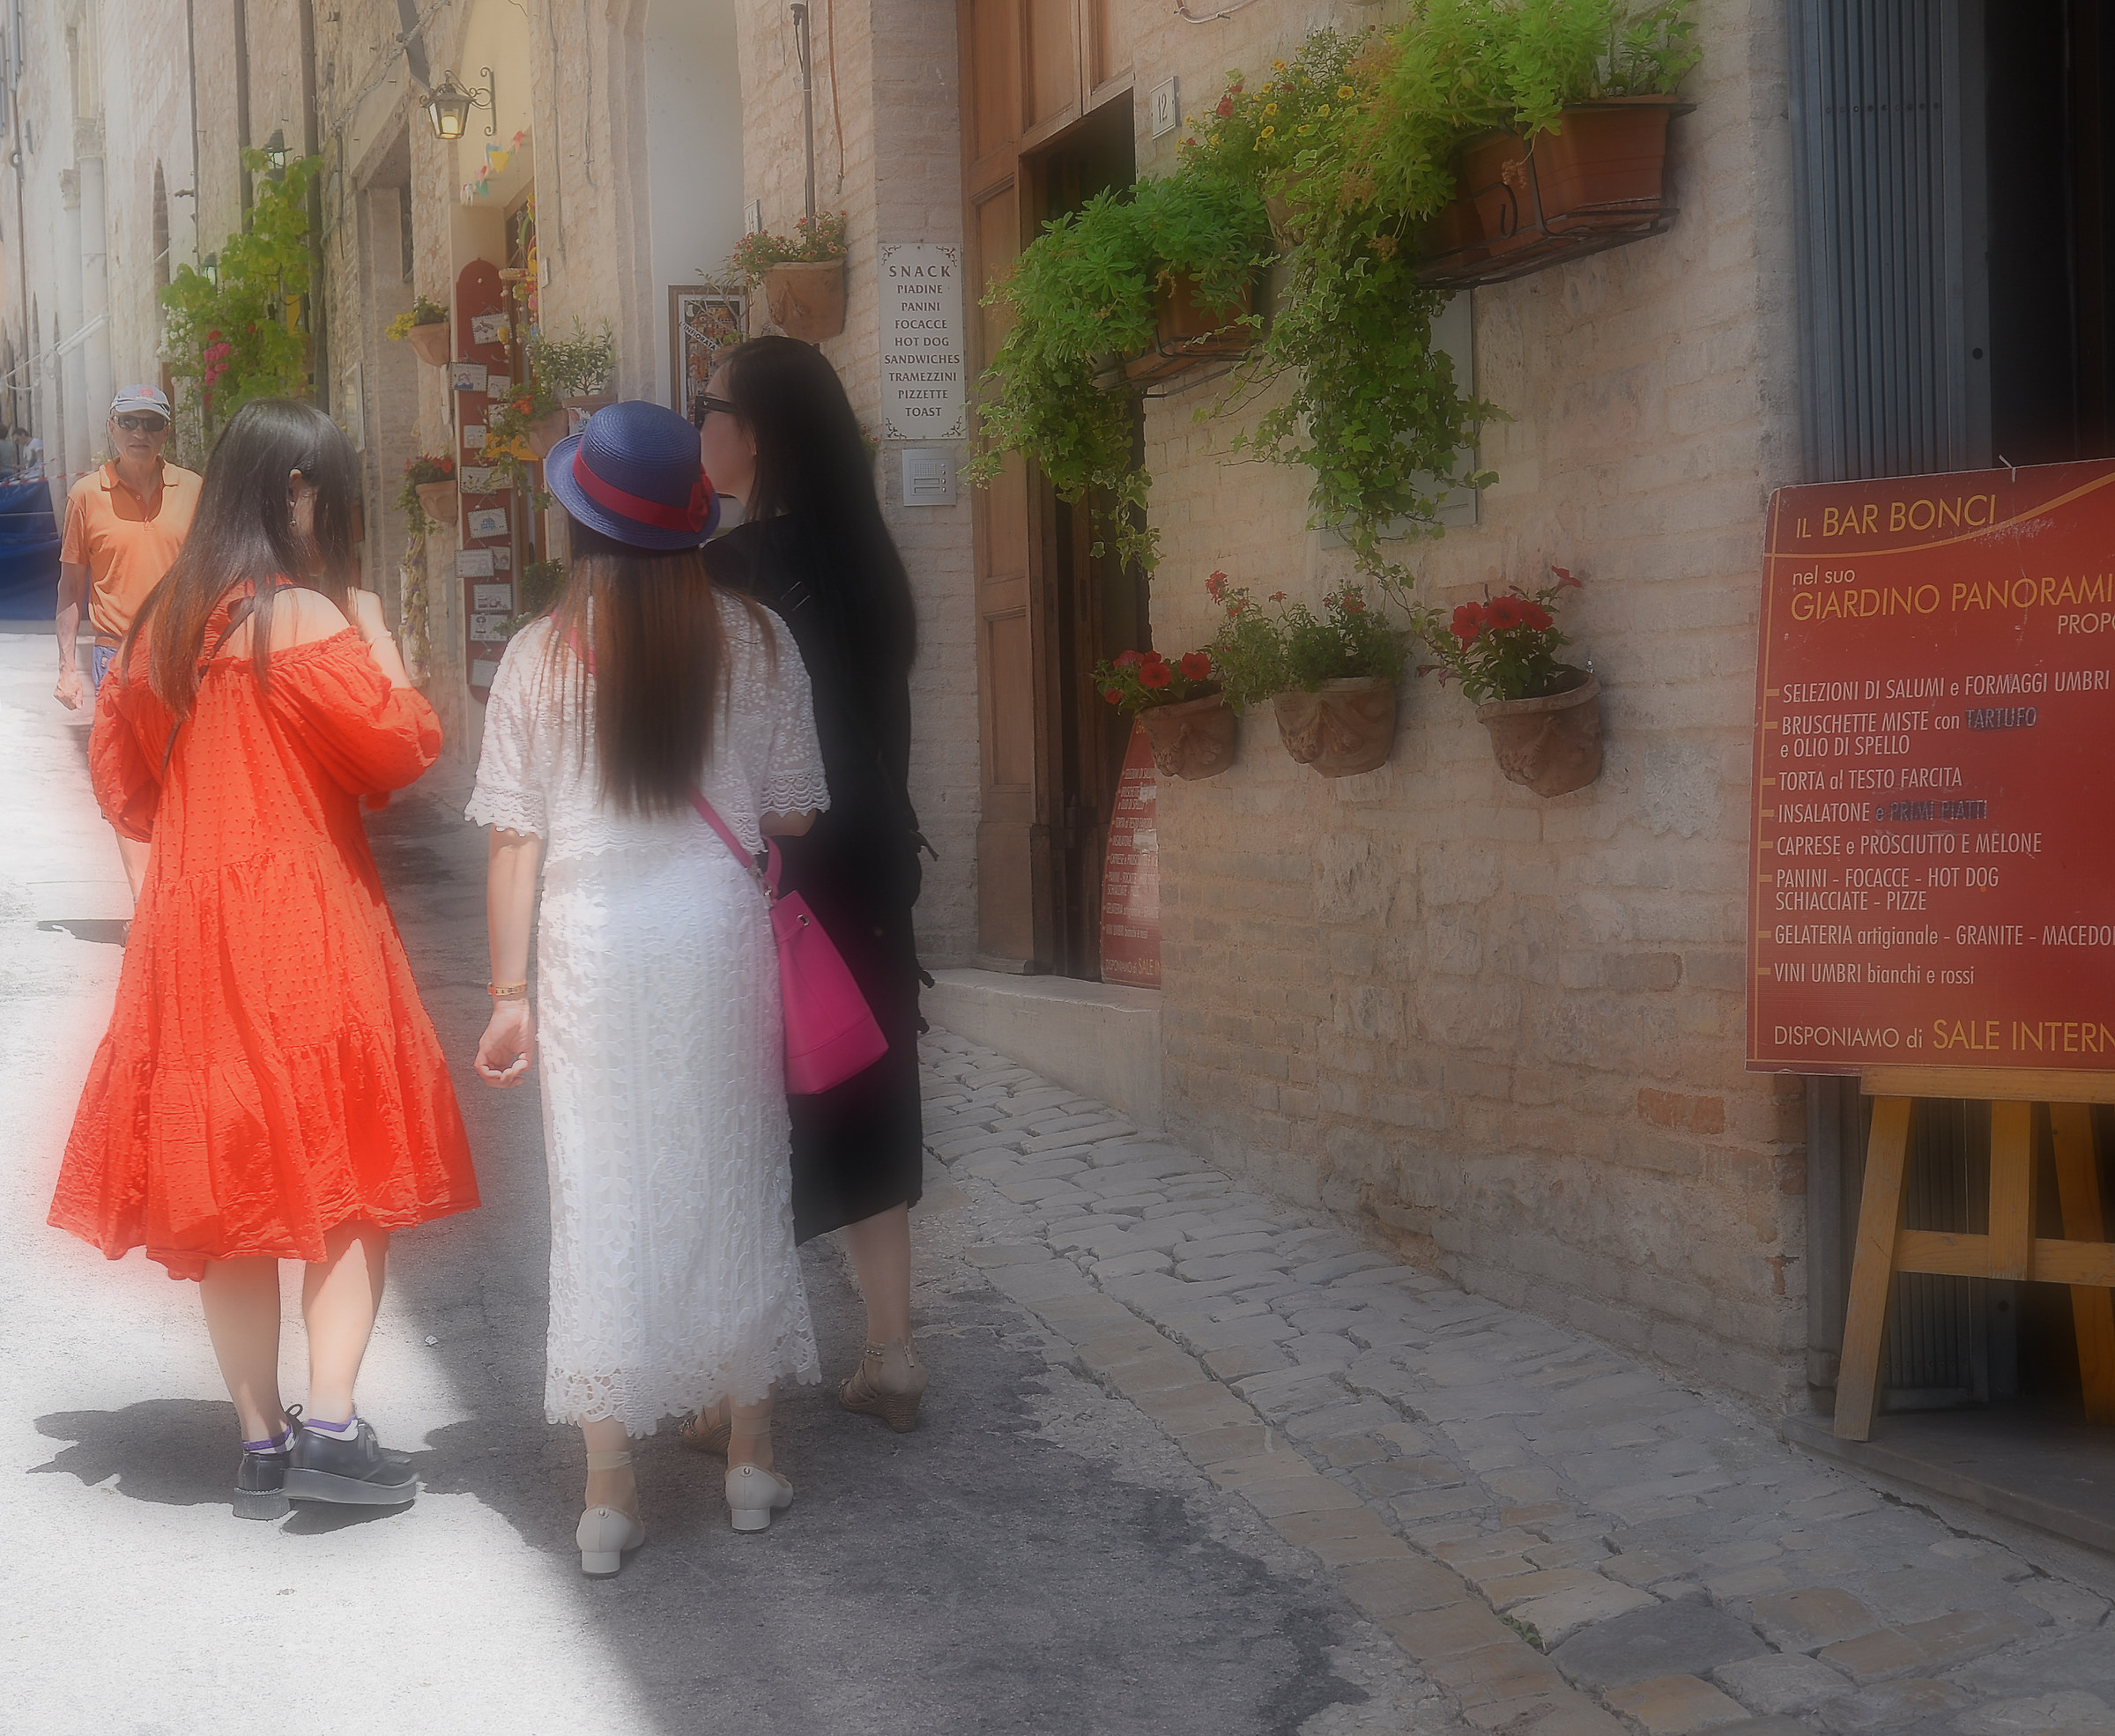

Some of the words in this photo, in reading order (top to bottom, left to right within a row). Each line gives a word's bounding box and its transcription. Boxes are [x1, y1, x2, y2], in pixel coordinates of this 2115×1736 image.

[1157, 93, 1168, 123] 12
[889, 266, 951, 278] SNACK
[897, 285, 943, 293] PIADINE
[902, 302, 940, 311] PANINI
[895, 320, 947, 329] FOCACCE
[894, 337, 919, 346] HOT
[924, 337, 949, 346] DOG
[884, 354, 960, 364] SANDWICHES
[888, 372, 957, 382] TRAMEZZINI
[898, 389, 948, 399] PIZZETTE
[905, 407, 942, 417] TOAST
[1796, 518, 1811, 538] IL
[1822, 504, 1879, 537] BAR
[1889, 494, 1996, 532] BONCI
[1792, 565, 1819, 585] nel
[1824, 569, 1856, 584] suo
[1791, 584, 1941, 621] GIARDINO
[1951, 573, 2112, 612] PANORAMI
[2058, 612, 2115, 634] PROP
[1783, 681, 1859, 703] SELEZIONI
[1865, 680, 1881, 700] DI
[1886, 677, 1945, 699] SALUMI
[1950, 682, 1959, 696] e
[1965, 672, 2048, 696] FORMAGGI
[2054, 670, 2111, 692] UMBRI
[1782, 713, 1877, 736] BRUSCHETTE
[1881, 711, 1929, 732] MISTE
[1934, 714, 1960, 731] con
[1966, 707, 2037, 729] TARTUFO
[1780, 744, 1789, 758] e
[1793, 737, 1829, 758] OLIO
[1834, 737, 1850, 756] DI
[1854, 734, 1911, 756] SPELLO
[1778, 771, 1825, 790] TORTA
[1829, 769, 1844, 790] al
[1849, 768, 1895, 790] TESTO
[1901, 767, 1963, 787] FARCITA
[1777, 803, 1870, 823] INSALATONE
[1875, 806, 1885, 821] e
[1777, 836, 1841, 856] CAPRESE
[1846, 842, 1855, 855] e
[1860, 834, 1955, 855] PROSCIUTTO
[1961, 834, 1970, 854] E
[1975, 832, 2042, 854] MELONE
[1777, 868, 1827, 888] PANINI
[1845, 868, 1910, 887] FOCACCE
[1928, 867, 1960, 887] HOT
[1965, 866, 1999, 887] DOG
[1776, 891, 1868, 911] SCHIACCIATE
[1887, 891, 1927, 910] PIZZE
[1775, 924, 1852, 945] GELATERIA
[1857, 924, 1938, 949] artigianale
[1956, 925, 2023, 946] GRANITE
[2042, 925, 2115, 946] MACEDO
[1774, 962, 1805, 982] VINI
[1811, 963, 1861, 983] UMBRI
[1867, 962, 1920, 983] bianchi
[1926, 969, 1935, 983] e
[1941, 966, 1974, 984] rossi
[1774, 1026, 1900, 1048] DISPONIAMO
[1906, 1028, 1923, 1048] di
[1933, 1020, 2000, 1050] SALE
[2012, 1021, 2115, 1052] INTERN
